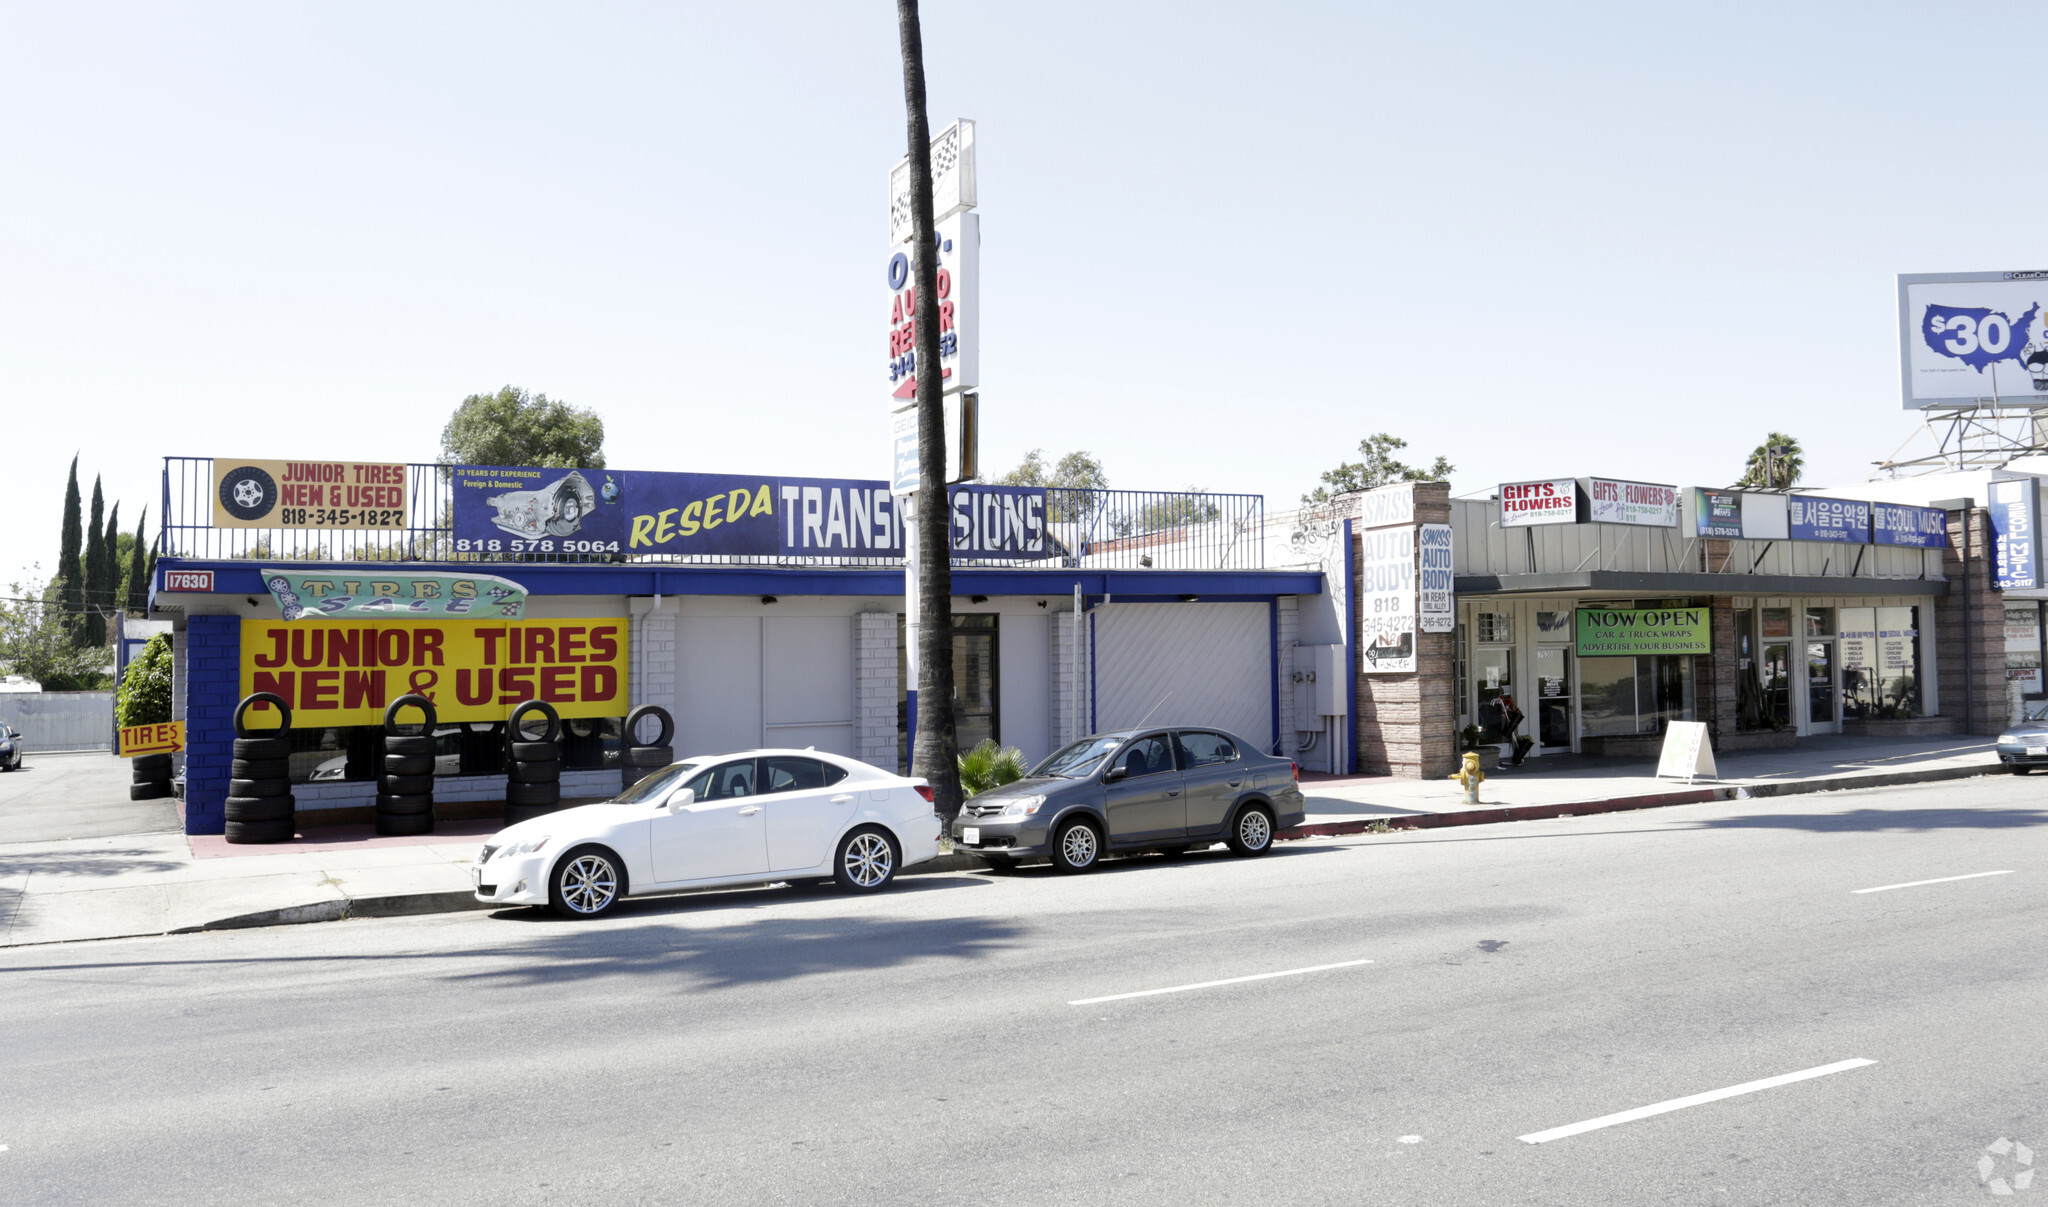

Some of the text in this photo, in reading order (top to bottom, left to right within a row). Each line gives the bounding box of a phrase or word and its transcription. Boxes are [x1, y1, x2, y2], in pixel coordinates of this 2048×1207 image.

[891, 268, 951, 325] AUO
[1930, 314, 2011, 355] $30
[281, 463, 404, 484] JUNIOR TIRES
[466, 469, 489, 477] YEARS
[463, 480, 487, 489] Foreign
[494, 481, 523, 489] Domestic
[1503, 482, 1571, 500] GIFTS &
[1593, 481, 1618, 502] GIFTS
[1625, 485, 1663, 506] FLOWERS
[281, 484, 402, 508] NEW & USED
[1504, 496, 1573, 512] FLOWERS
[1364, 489, 1412, 523] SWISS
[1530, 509, 1573, 517] 818-758-0217
[1625, 505, 1663, 514] 818-758-0217
[1804, 501, 1868, 530] 서울음악원
[281, 508, 404, 526] 818-345-1827
[629, 484, 773, 549] RESEDA
[1625, 514, 1637, 522] 818
[1887, 507, 1916, 532] SEOUL
[1918, 513, 1944, 534] MUSIC
[2008, 502, 2028, 540] SEOUL
[1421, 528, 1452, 547] SWISS
[1699, 526, 1714, 536] (818)
[456, 539, 620, 553] 818 578 5064
[1364, 531, 1411, 562] AUTO
[1422, 548, 1451, 569] AUTO
[2009, 541, 2029, 579] MUSIC
[169, 574, 209, 590] 17630
[1364, 562, 1413, 593] BODY
[1422, 570, 1452, 590] BODY
[1993, 578, 2033, 588] 343-5117
[301, 579, 478, 598] TIRES
[1423, 592, 1446, 601] IN REAR
[317, 596, 477, 614] SALE
[1374, 596, 1400, 613] 818
[1588, 611, 1639, 628] NOW
[1643, 610, 1700, 627] OPEN
[1595, 630, 1693, 639] CAR & TRUCK WRAPS
[254, 626, 617, 668] JUNIOR TIRES
[1582, 641, 1707, 651] ADVERTISE YOUR BUSINESS
[252, 665, 618, 711] NEW & USED
[122, 725, 177, 746] TIRES
